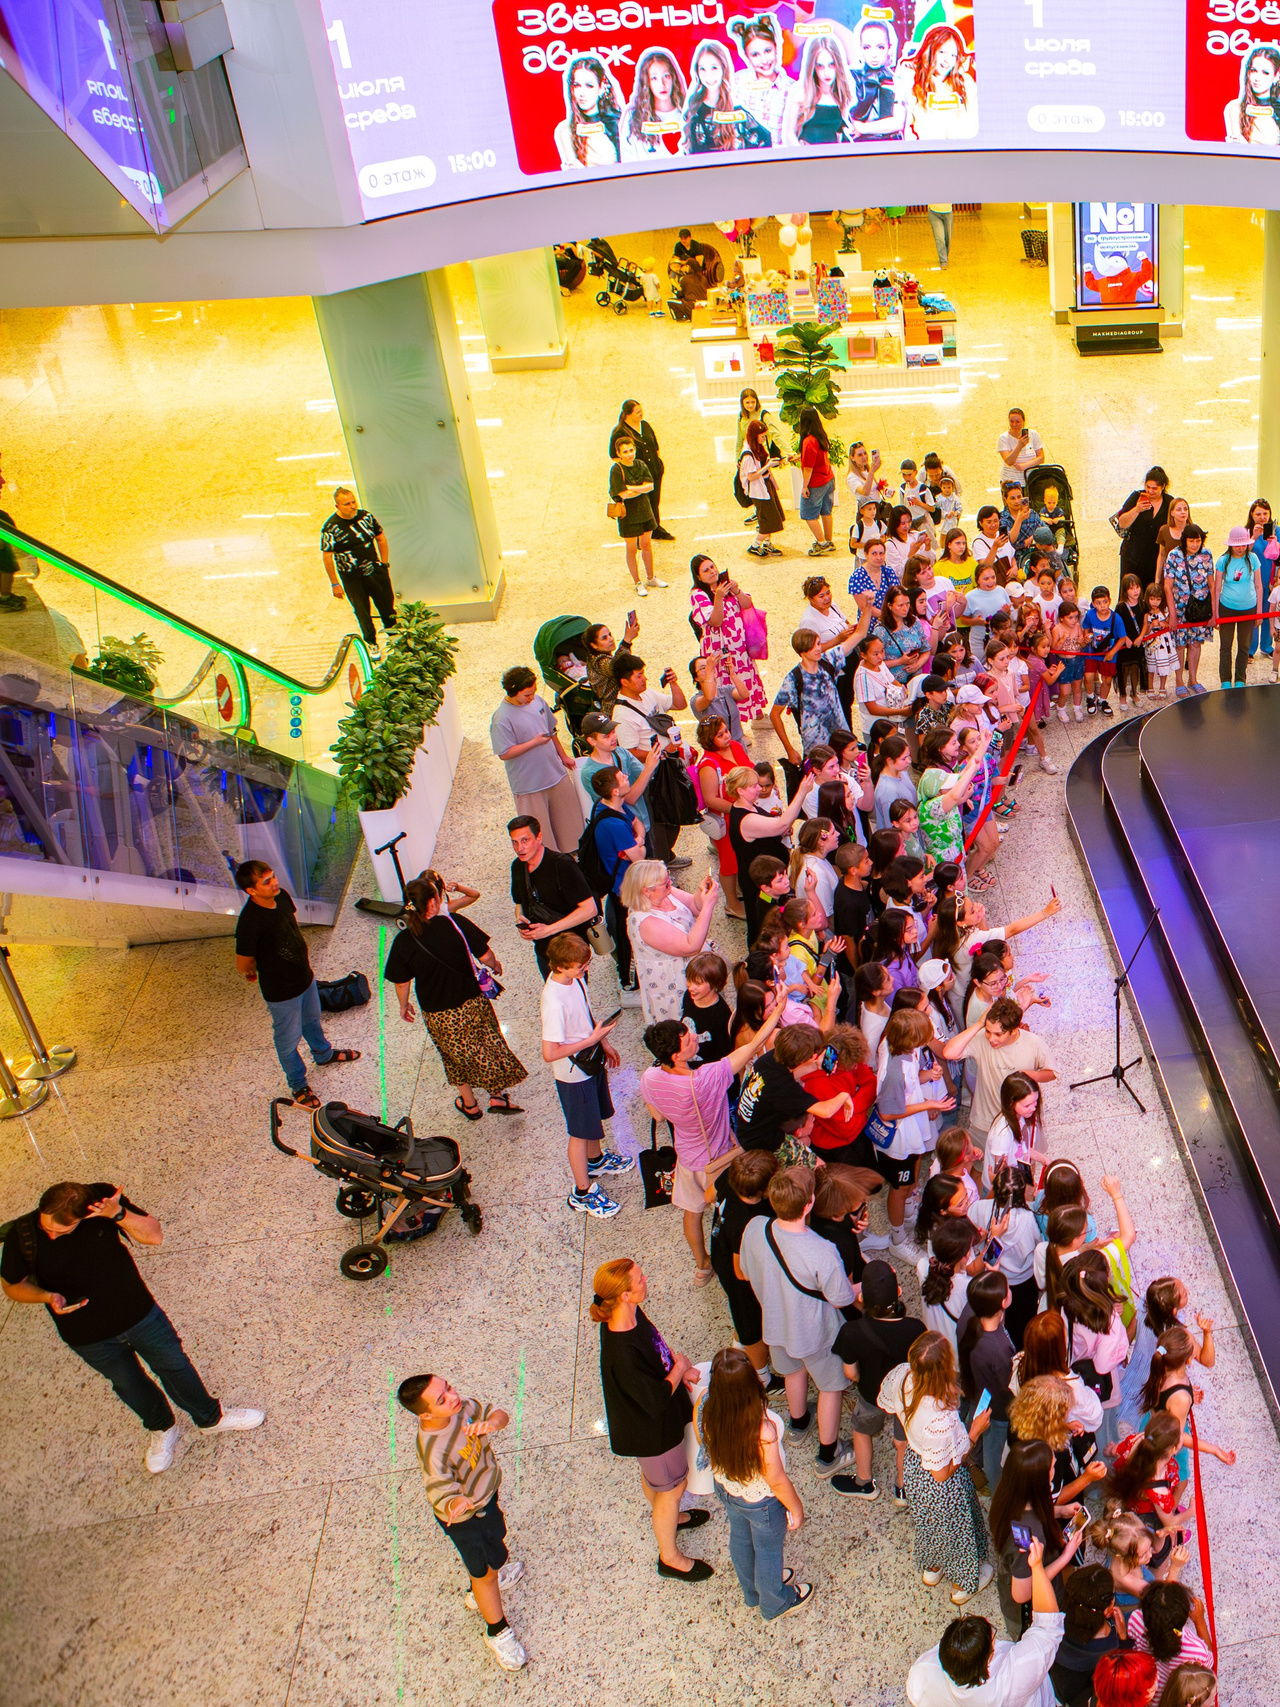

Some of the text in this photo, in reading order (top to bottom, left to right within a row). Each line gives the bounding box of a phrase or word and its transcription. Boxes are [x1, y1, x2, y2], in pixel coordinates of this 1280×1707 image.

[326, 19, 352, 69] 1
[1024, 38, 1091, 52] июля
[522, 40, 636, 74] двж
[1024, 59, 1097, 78] среда
[337, 76, 406, 99] июля
[344, 102, 417, 131] среда
[1118, 110, 1166, 127] 15:00
[368, 149, 497, 188] 0 этаж 15:00
[1092, 329, 1144, 338] MAXMEDIAGROUP
[898, 1170, 911, 1182] 18
